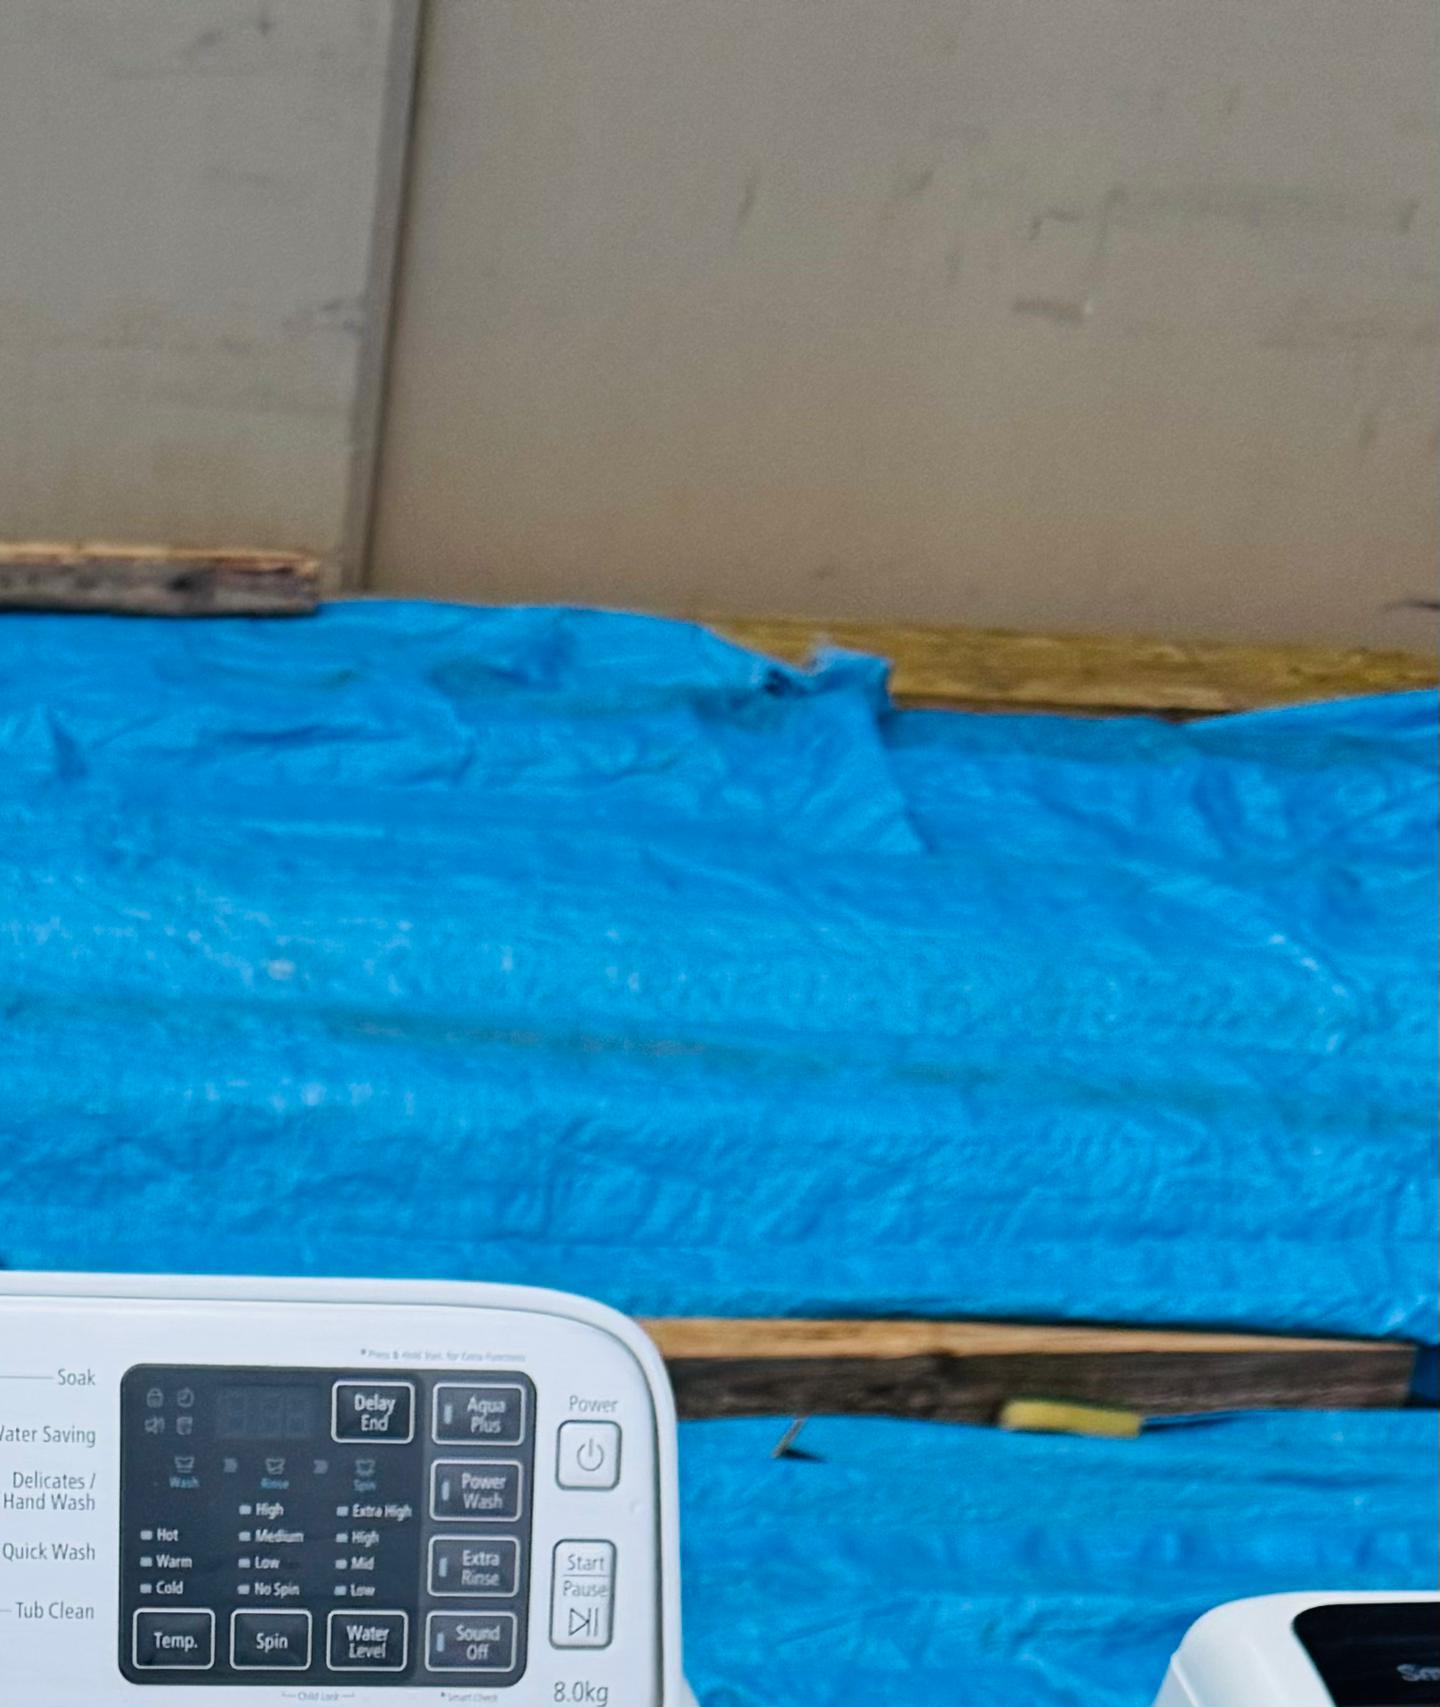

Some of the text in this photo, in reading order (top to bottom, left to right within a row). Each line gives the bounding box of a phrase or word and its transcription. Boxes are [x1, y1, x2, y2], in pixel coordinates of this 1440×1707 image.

[57, 1368, 96, 1387] Soak
[353, 1393, 396, 1417] Delay
[466, 1397, 506, 1418] Aqua
[569, 1395, 619, 1413] Power
[361, 1415, 389, 1432] End
[470, 1416, 501, 1433] Plus
[42, 1426, 96, 1449] Saving
[12, 1471, 84, 1490] Delicates
[462, 1473, 507, 1490] Power
[3, 1493, 96, 1511] Hand Wash
[463, 1492, 503, 1509] Wash
[255, 1502, 284, 1519] High
[352, 1503, 412, 1519] Extra High
[157, 1528, 179, 1542] Hot
[255, 1529, 304, 1544] Medium
[352, 1530, 379, 1546] High
[2, 1543, 96, 1563] Quick Wash
[156, 1554, 192, 1569] Warm
[462, 1551, 500, 1567] Extra
[254, 1556, 280, 1570] Low
[351, 1556, 375, 1571] Mid
[566, 1553, 605, 1571] Start
[461, 1569, 500, 1586] Rinse
[156, 1581, 184, 1596] Cold
[254, 1582, 300, 1599] No Spin
[350, 1583, 375, 1597] Low
[562, 1580, 609, 1598] Pause
[15, 1602, 95, 1620] Tub Clean
[346, 1625, 390, 1642] Water
[456, 1624, 501, 1642] Sound
[154, 1632, 198, 1652] Temp.
[255, 1633, 288, 1651] Spin
[348, 1642, 386, 1660] Level
[466, 1643, 490, 1660] Off
[553, 1680, 609, 1707] 8.0kg
